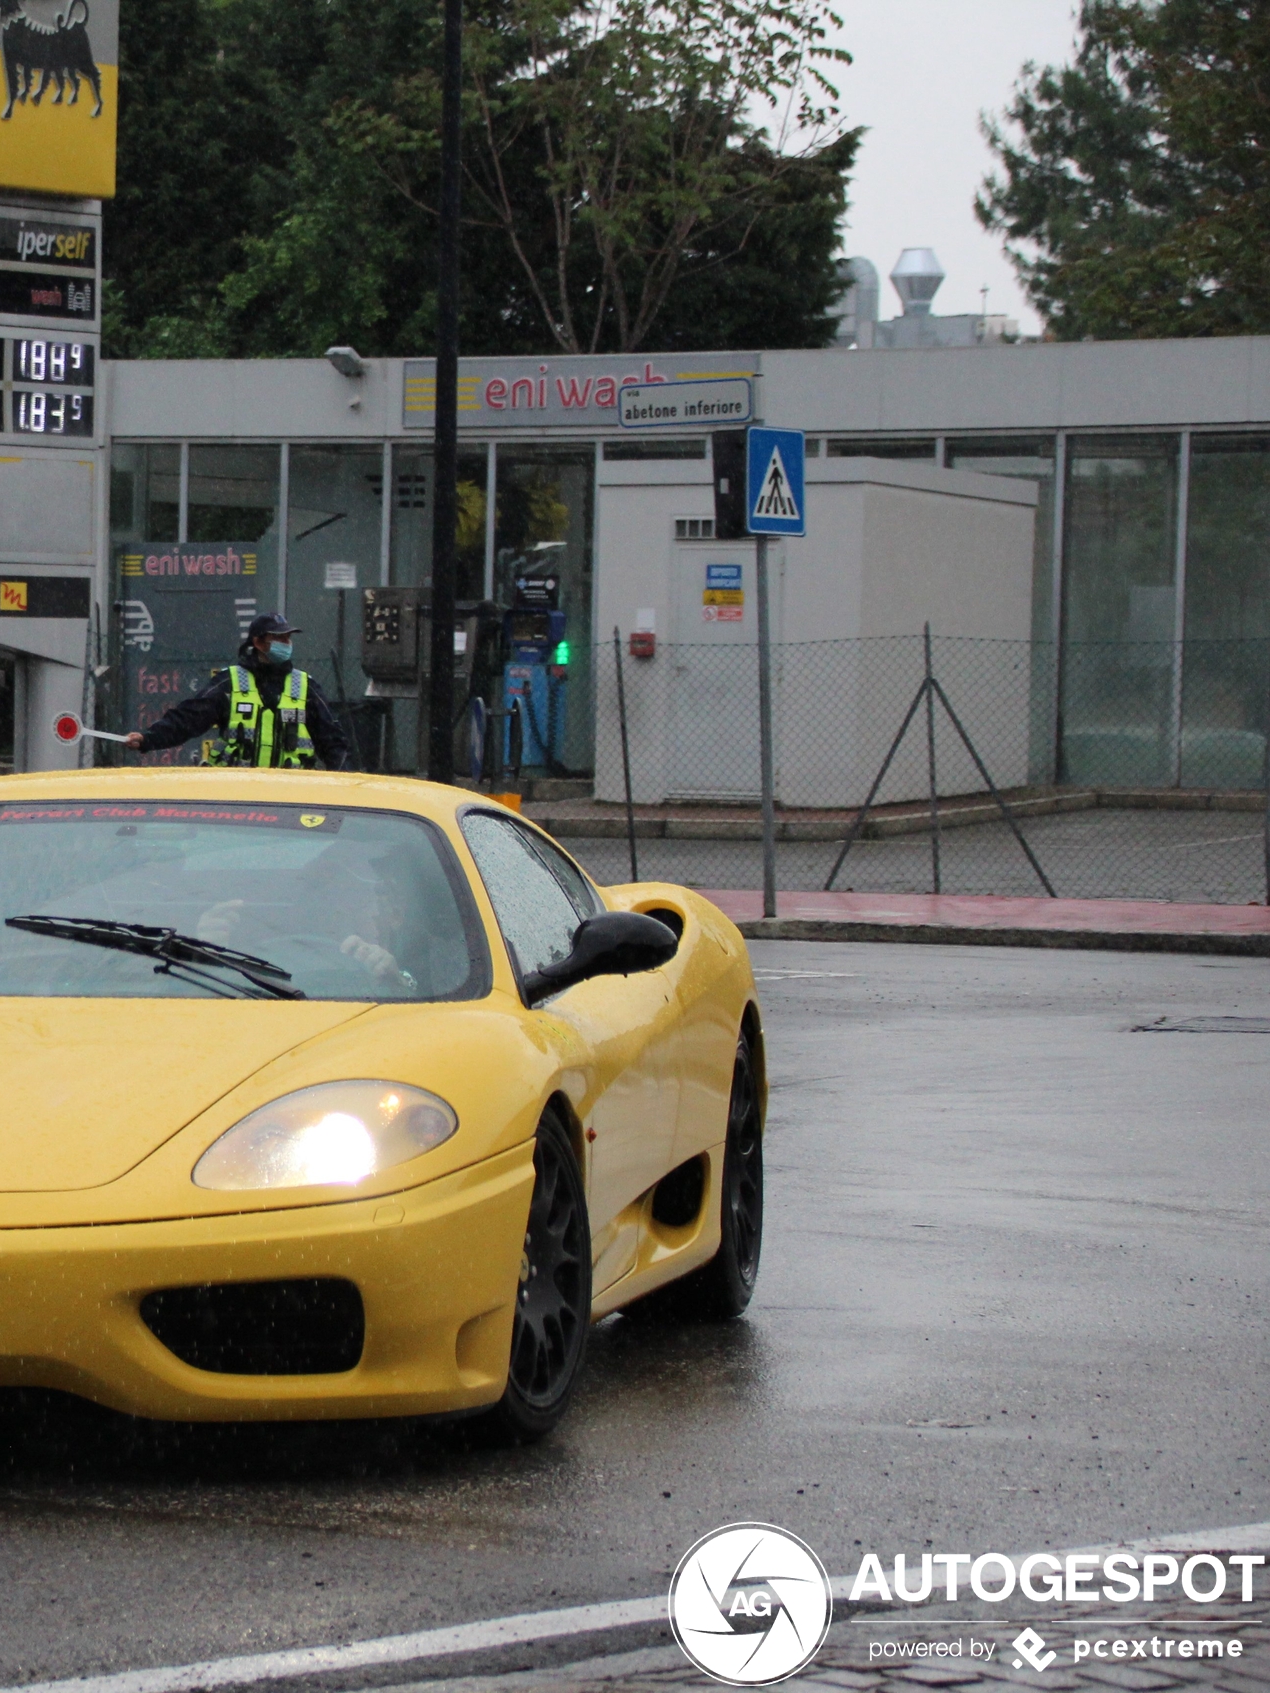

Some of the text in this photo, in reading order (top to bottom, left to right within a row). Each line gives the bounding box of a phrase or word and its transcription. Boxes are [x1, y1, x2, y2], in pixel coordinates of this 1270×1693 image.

[17, 222, 91, 261] iperself
[485, 362, 668, 409] eni wa
[625, 400, 743, 421] abetone inferiore
[145, 546, 241, 576] eni wash
[137, 666, 180, 694] fast
[92, 807, 147, 817] Club
[153, 807, 278, 823] Maranello
